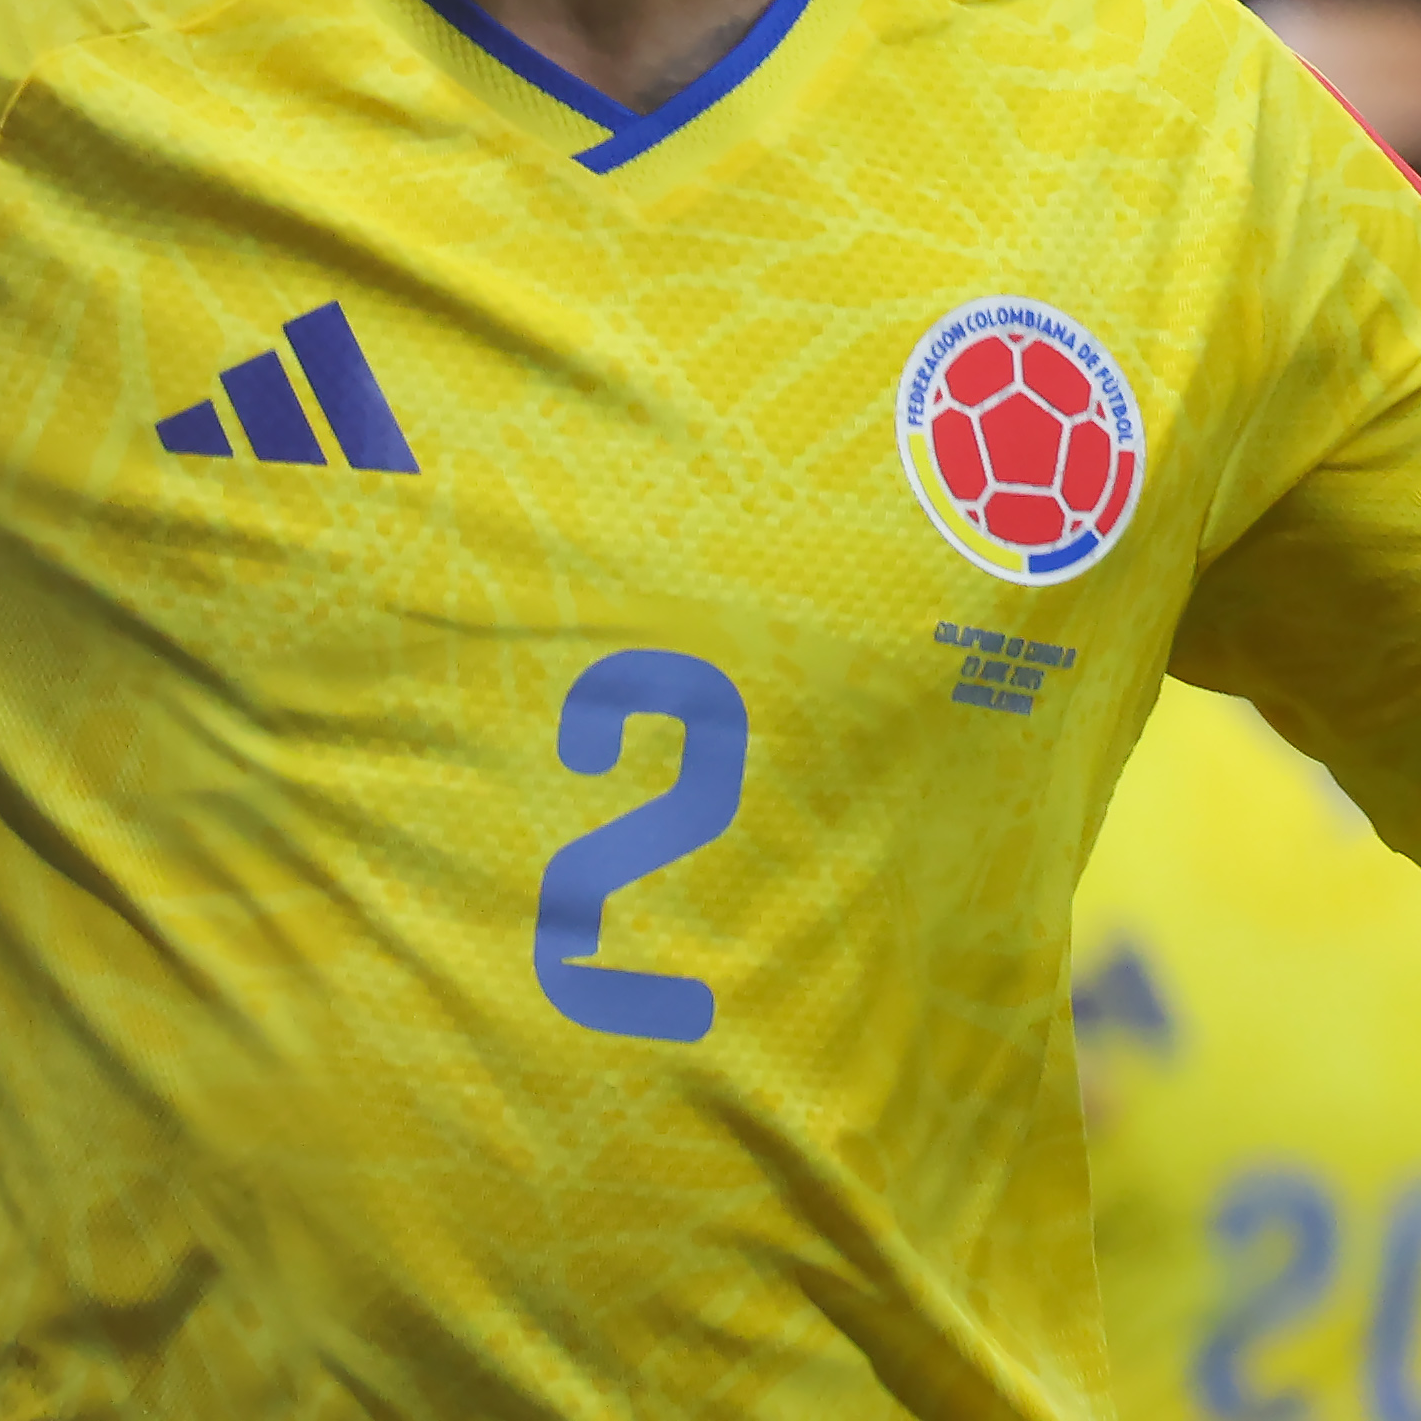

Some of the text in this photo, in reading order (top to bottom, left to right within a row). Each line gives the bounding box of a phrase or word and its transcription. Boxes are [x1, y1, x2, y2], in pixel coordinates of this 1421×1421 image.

[966, 305, 1076, 350] COLOMBIANA
[1077, 343, 1100, 370] DE
[535, 650, 747, 1042] 2
